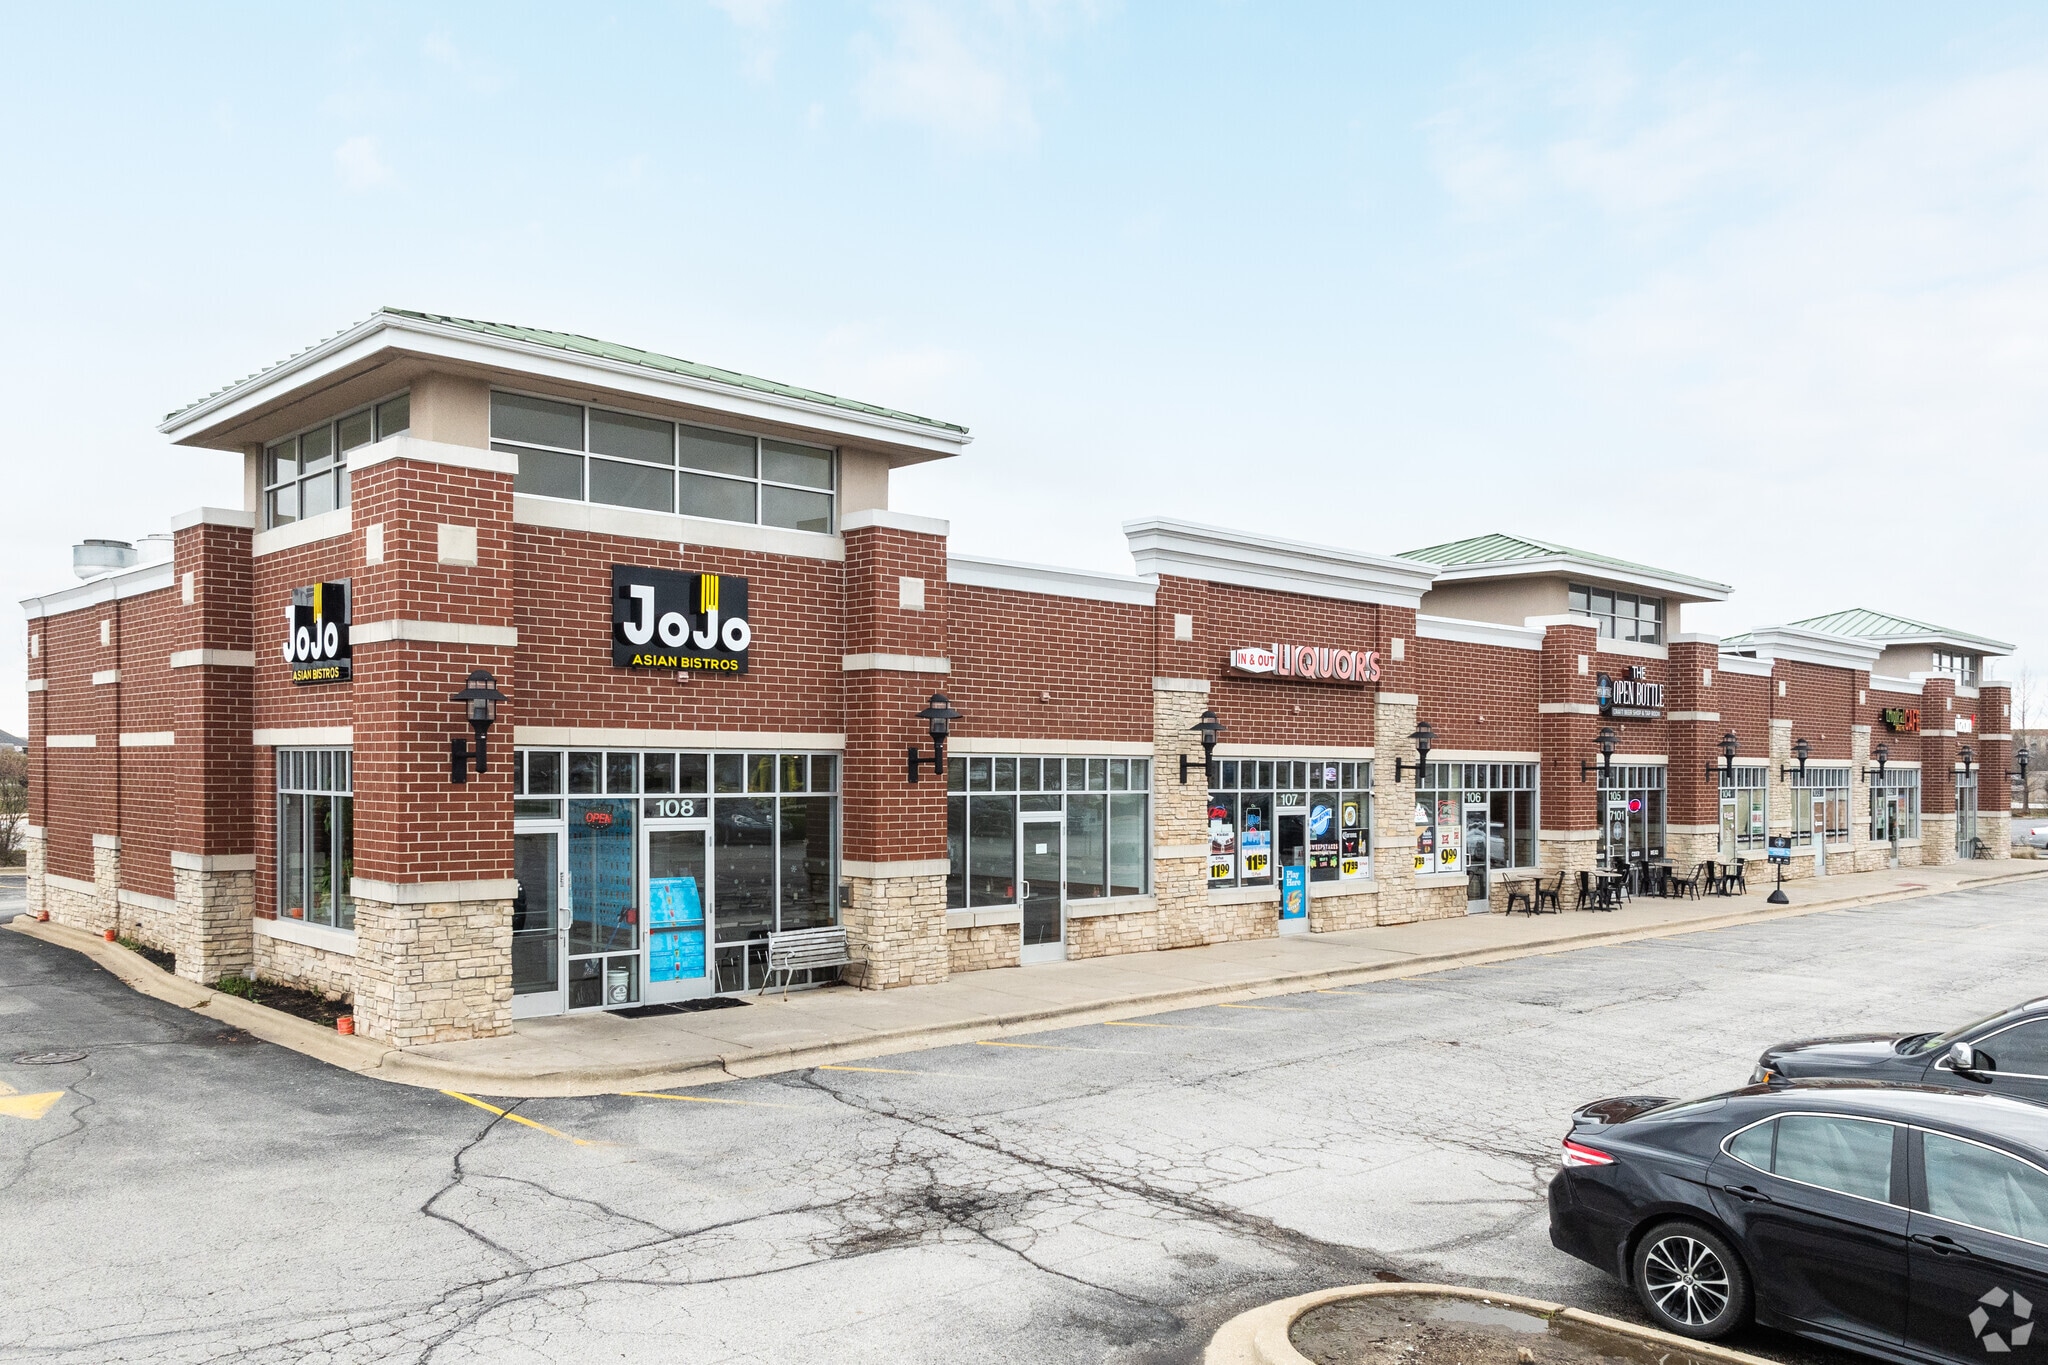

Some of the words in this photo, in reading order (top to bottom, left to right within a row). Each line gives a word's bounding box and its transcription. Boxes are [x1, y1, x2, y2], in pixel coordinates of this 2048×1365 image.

[623, 583, 752, 652] JoJo
[283, 604, 339, 663] JoJo
[632, 654, 678, 668] ASIAN
[680, 657, 739, 672] BISTROS
[1237, 652, 1247, 665] IN
[1249, 653, 1256, 666] &
[1257, 654, 1276, 668] OUT
[1277, 643, 1381, 682] LIQUORS
[292, 668, 312, 681] ASIAN
[312, 666, 340, 680] BISTROS
[1632, 665, 1647, 680] THE
[1613, 680, 1635, 705] OPEN
[1636, 682, 1665, 708] BOTTLE
[1280, 793, 1299, 806] 107
[1467, 792, 1481, 803] 106
[1610, 791, 1622, 801] 105
[1722, 790, 1732, 798] 104
[655, 799, 695, 818] 108
[1610, 810, 1625, 821] 7101
[585, 812, 613, 825] OPEN
[1286, 870, 1299, 879] Play
[1286, 878, 1301, 887] Here
